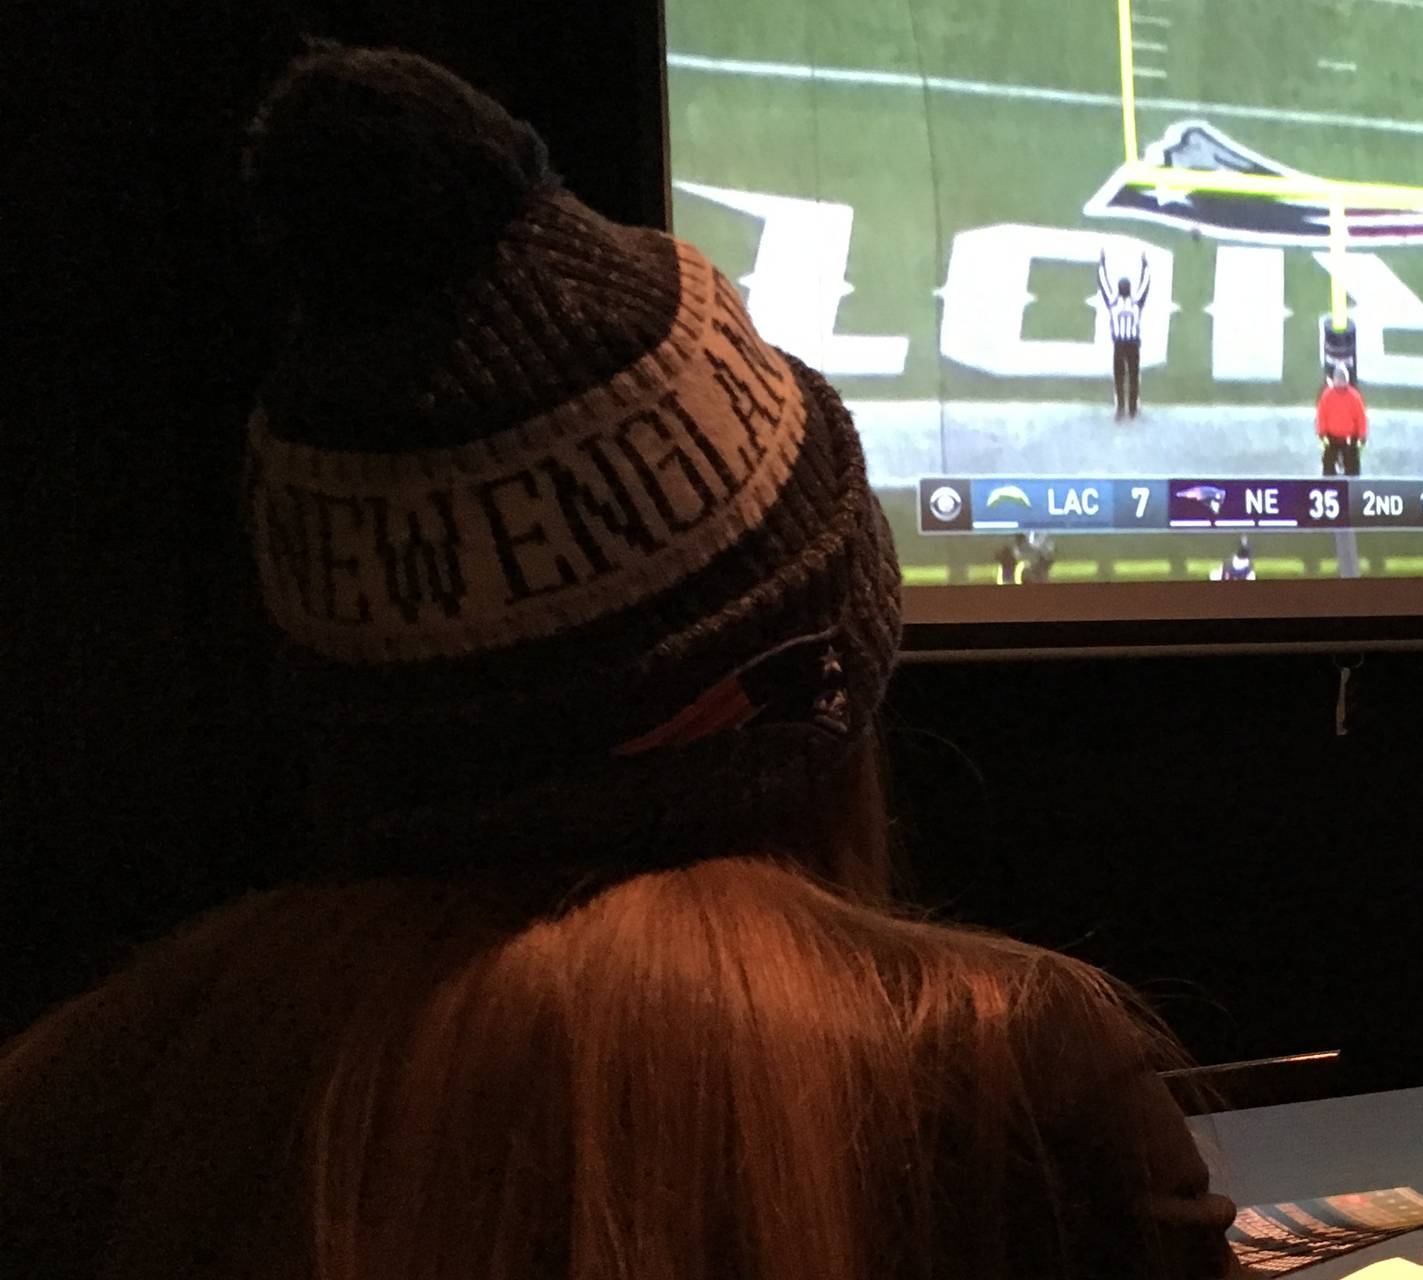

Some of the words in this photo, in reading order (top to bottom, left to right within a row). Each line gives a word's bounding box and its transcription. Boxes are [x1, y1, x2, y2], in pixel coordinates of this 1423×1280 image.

[1047, 487, 1100, 516] LAC
[1131, 487, 1150, 518] 7
[1244, 488, 1280, 515] NE
[1308, 488, 1341, 520] 35
[1362, 490, 1404, 517] 2ND
[268, 483, 467, 627] NEW
